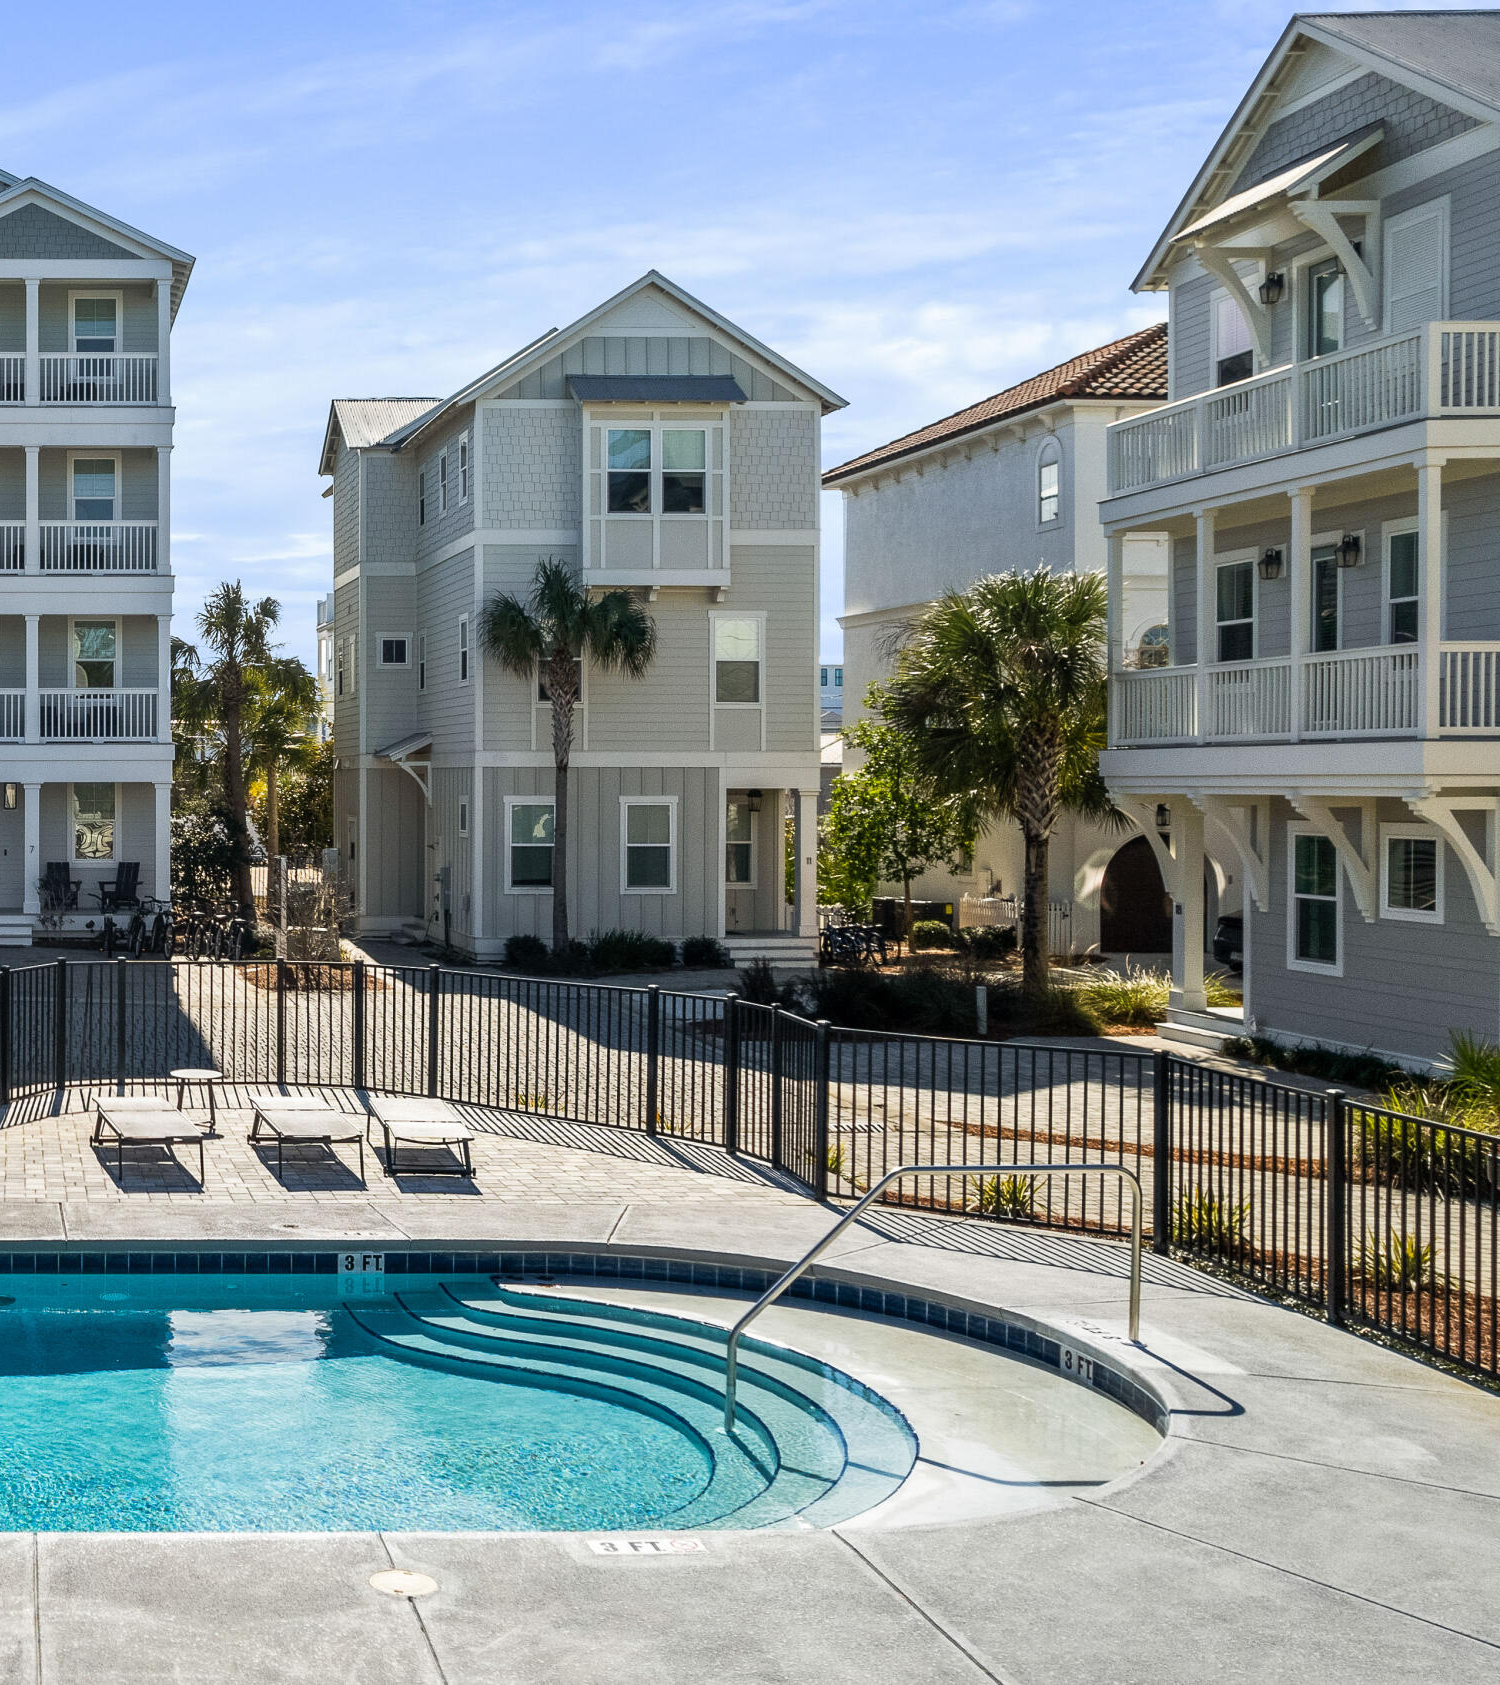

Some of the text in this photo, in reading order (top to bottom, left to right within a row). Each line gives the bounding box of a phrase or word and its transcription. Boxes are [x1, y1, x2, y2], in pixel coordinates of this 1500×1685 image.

[345, 1255, 355, 1271] 3
[1064, 1350, 1073, 1370] 3
[600, 1542, 619, 1553] 3
